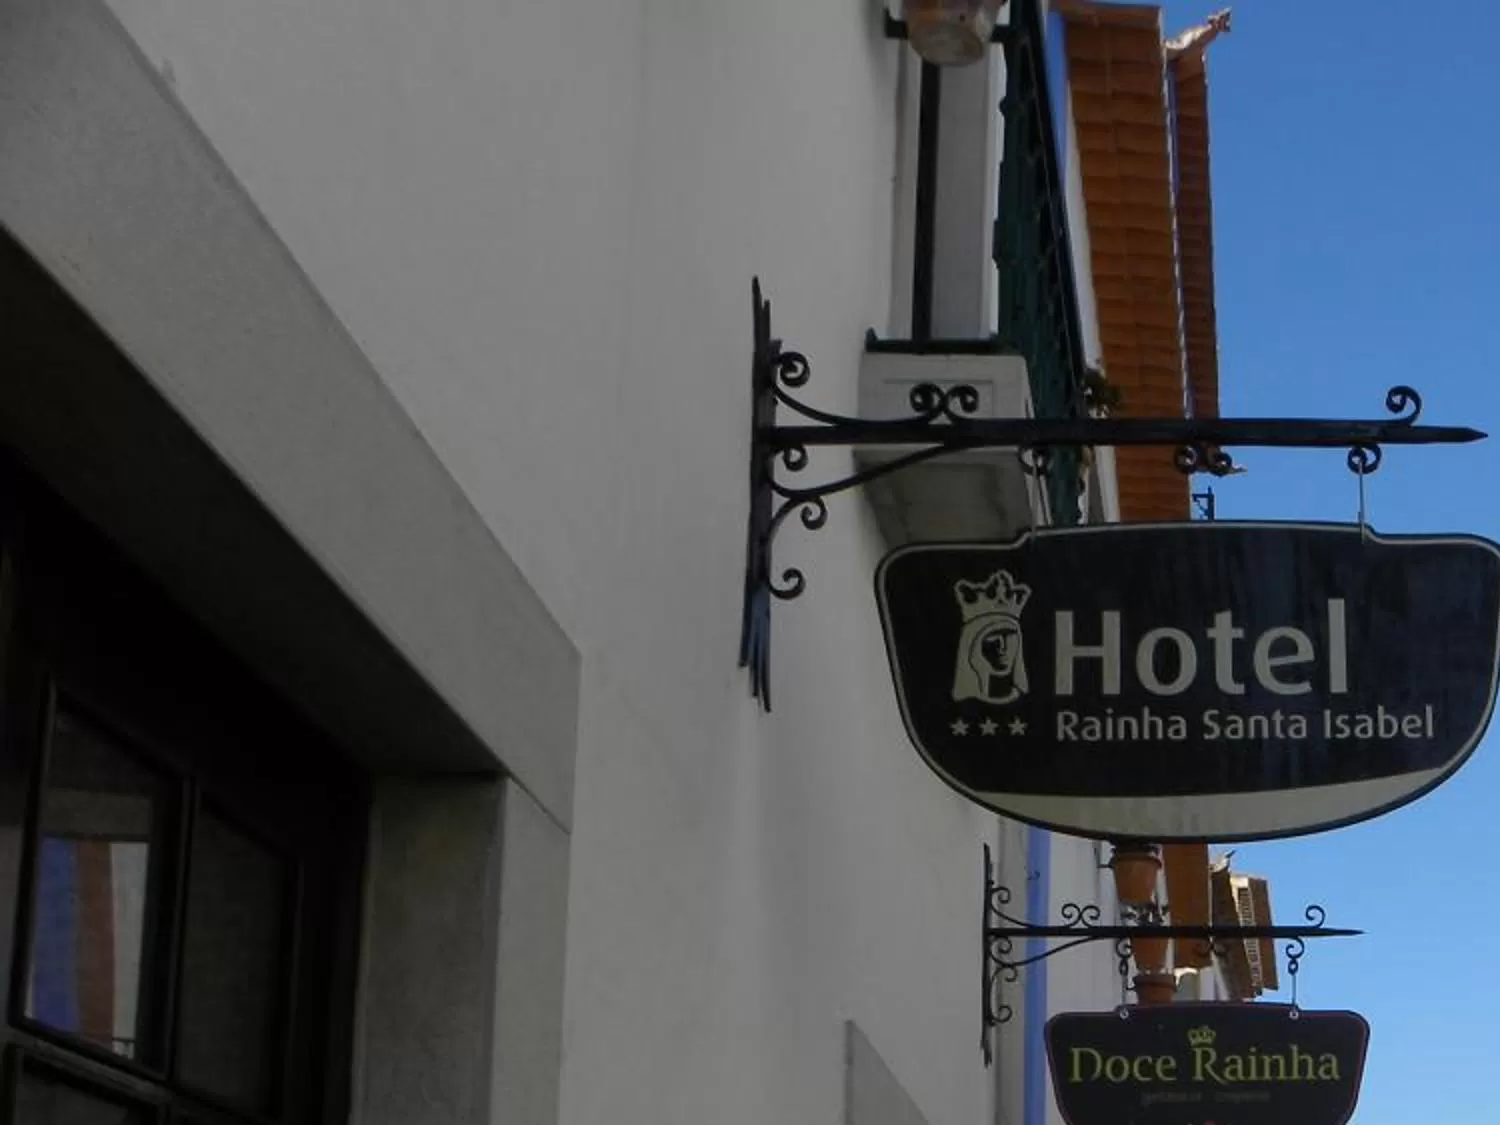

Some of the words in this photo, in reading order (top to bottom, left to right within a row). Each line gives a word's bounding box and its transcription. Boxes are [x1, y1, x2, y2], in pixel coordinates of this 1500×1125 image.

[1054, 597, 1349, 696] Hotel
[1056, 706, 1188, 742] Rainha
[1202, 707, 1308, 740] Santa
[1325, 704, 1435, 740] Isabel
[1068, 1046, 1178, 1083] Doce
[1191, 1043, 1341, 1085] Rainha
